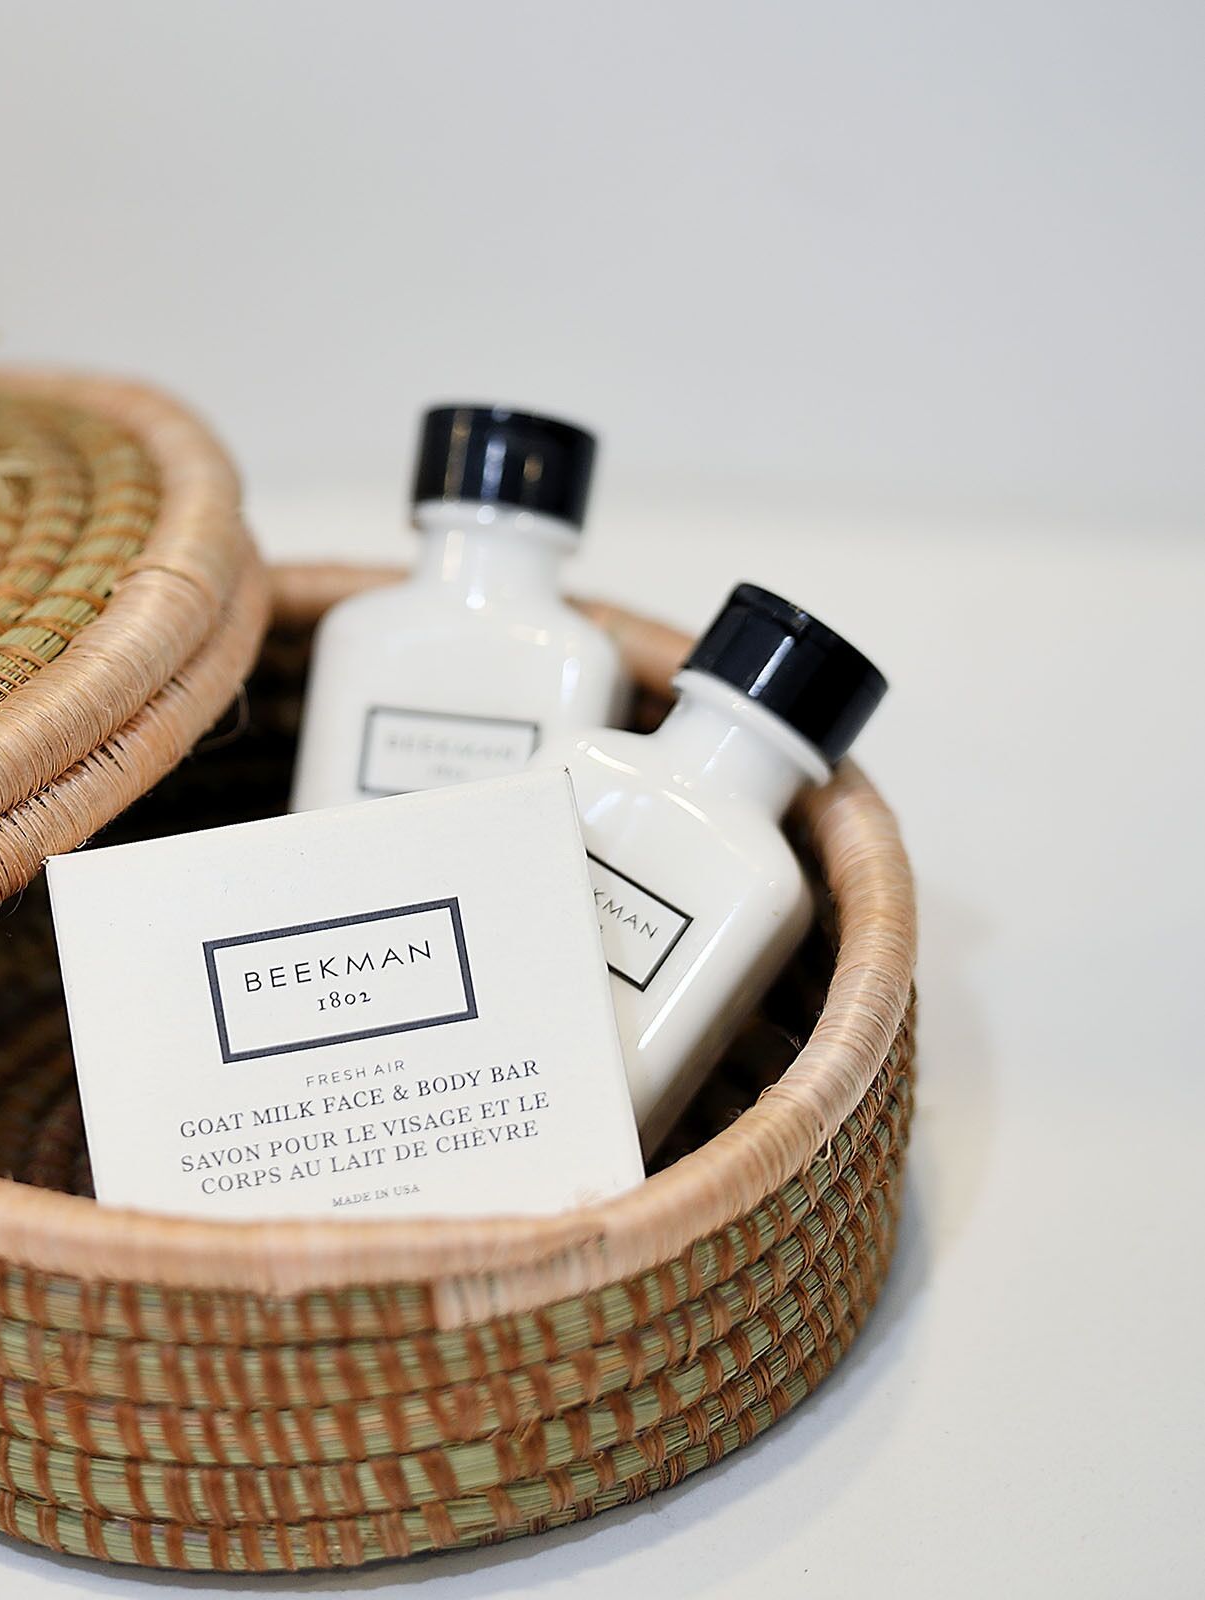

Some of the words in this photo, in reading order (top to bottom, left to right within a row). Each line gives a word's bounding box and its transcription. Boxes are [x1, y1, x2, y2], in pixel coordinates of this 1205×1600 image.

[244, 940, 432, 992] BEEKMAN
[317, 991, 371, 1011] 1802
[180, 1112, 244, 1138] GOAT
[252, 1100, 315, 1126] MILK
[323, 1088, 385, 1114] FACE
[393, 1084, 410, 1102] &
[416, 1069, 482, 1097] BODY
[490, 1059, 540, 1084] BAR
[306, 1066, 366, 1087] FRESH
[374, 1059, 405, 1076] AIR
[181, 1143, 261, 1173] SAVON
[269, 1131, 338, 1158] POUR
[346, 1123, 377, 1144] LE
[382, 1106, 472, 1137] VISAGE
[479, 1098, 510, 1120] ET
[517, 1091, 550, 1113] LE
[201, 1166, 282, 1195] CORPS
[290, 1159, 322, 1180] AU
[331, 1147, 386, 1173] LAIT
[395, 1140, 428, 1162] DE
[436, 1119, 539, 1154] CHÈVRE
[332, 1191, 372, 1207] MADE
[375, 1187, 389, 1200] IN
[393, 1184, 421, 1196] USA
